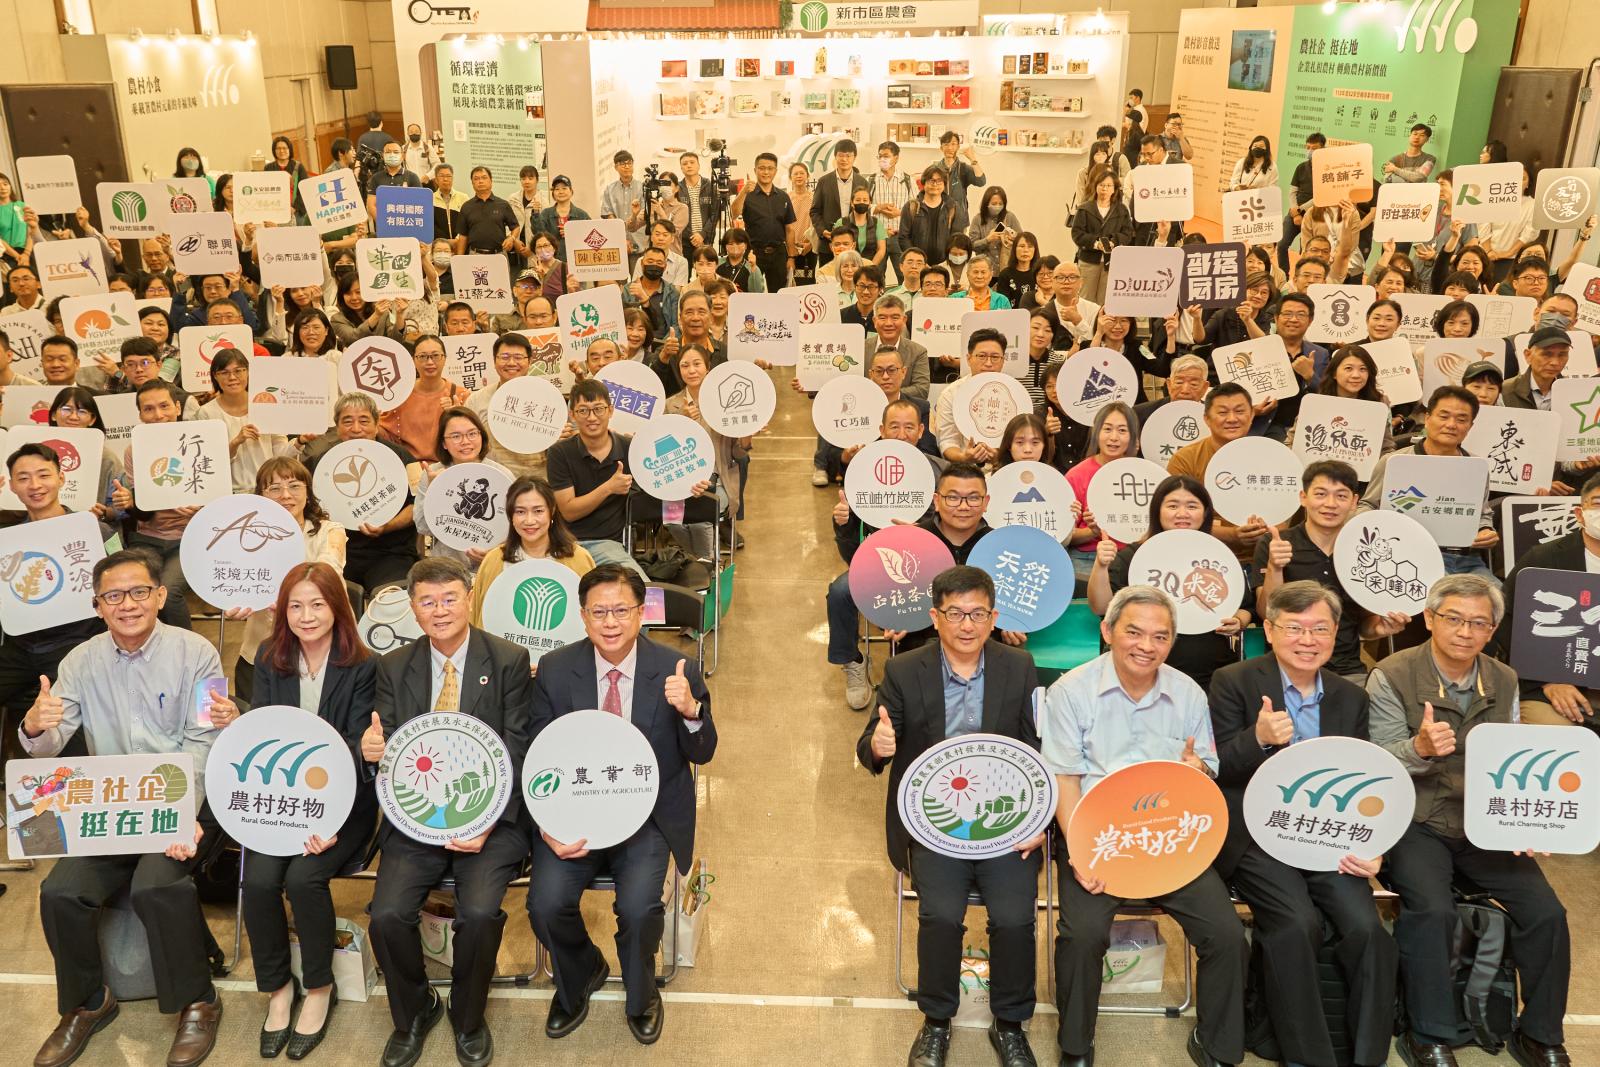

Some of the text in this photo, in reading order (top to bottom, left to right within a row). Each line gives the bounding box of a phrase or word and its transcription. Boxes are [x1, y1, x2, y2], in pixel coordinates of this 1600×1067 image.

[836, 5, 916, 19] 新市區農會
[1300, 38, 1359, 55] 農社企 挺在地
[450, 60, 498, 77] 循環經濟
[127, 76, 161, 95] 農村小食
[1489, 182, 1518, 195] 日茂
[386, 217, 424, 227] 有限公司
[46, 262, 79, 276] TGC
[833, 418, 848, 429] TC
[178, 433, 215, 494] 行健米
[653, 453, 698, 478] GOOD FARM
[1246, 473, 1297, 486] 佛都愛王
[352, 484, 397, 519] 林旺製茶廠
[1421, 506, 1476, 517] 吉安鄉農會
[212, 567, 273, 582] 茶境天使
[996, 550, 1051, 586] 天然
[1367, 575, 1425, 598] 采蜂林
[907, 605, 922, 614] Tea
[503, 632, 566, 649] 新市區農會
[571, 764, 653, 786] 農業部
[65, 774, 167, 805] 農社企
[571, 786, 653, 797] MINISTRY OF AGRICULTURE
[227, 790, 326, 820] 農村好物
[1486, 796, 1579, 820] 農村好店
[79, 808, 180, 839] 挺在地
[241, 816, 309, 830] Rural Good Products
[400, 819, 441, 841] Development
[470, 818, 490, 835] Water
[1264, 809, 1374, 843] 農村好物
[1517, 821, 1548, 830] Charming
[1548, 822, 1566, 831] Shop
[1277, 832, 1351, 851] Rural Good Products
